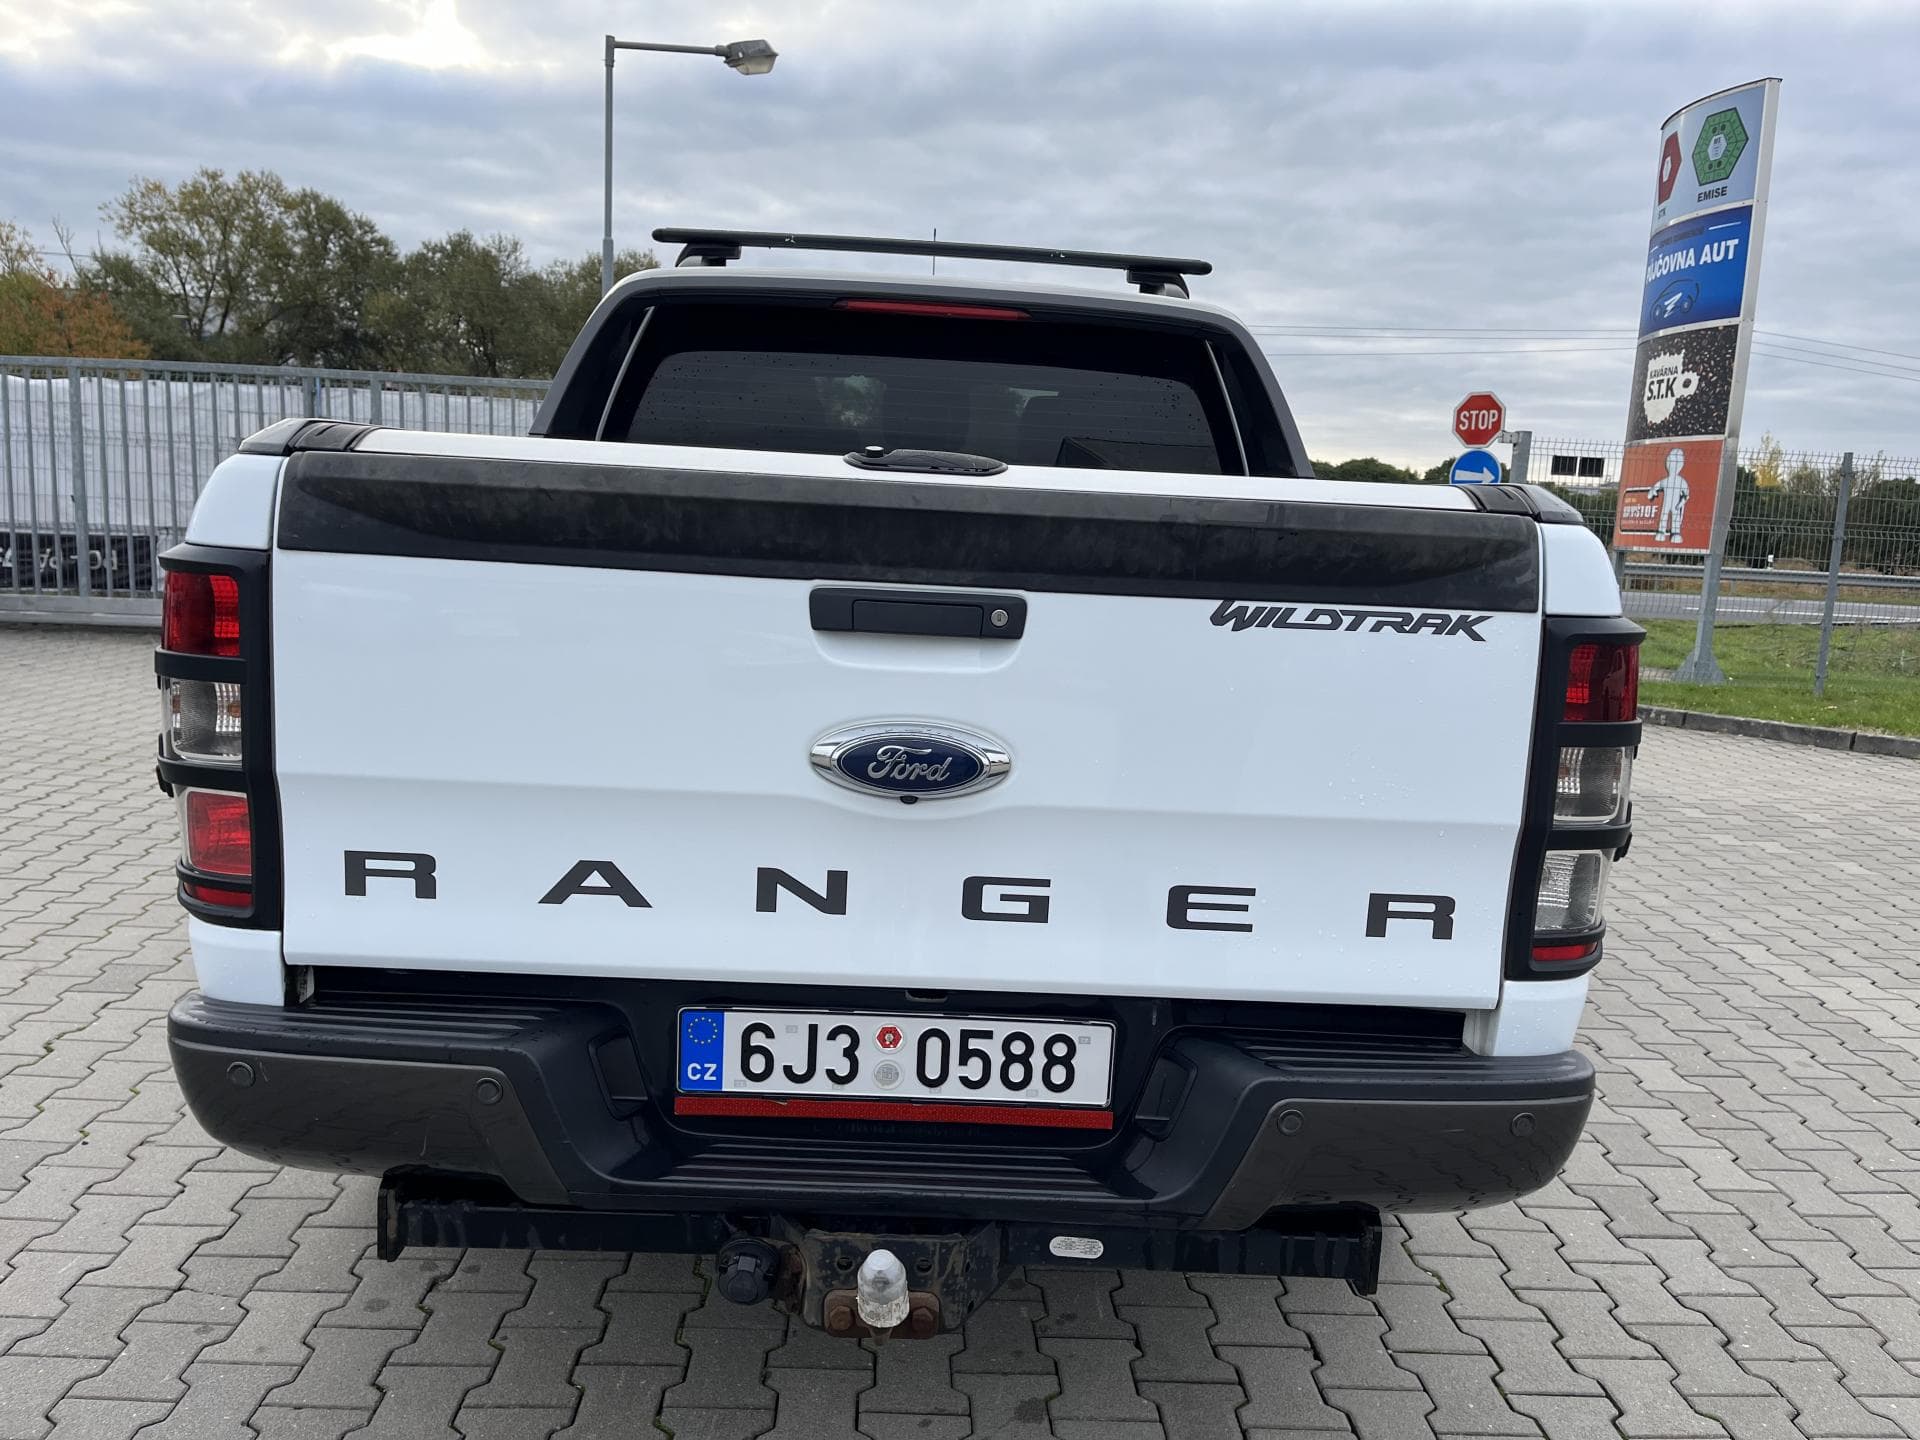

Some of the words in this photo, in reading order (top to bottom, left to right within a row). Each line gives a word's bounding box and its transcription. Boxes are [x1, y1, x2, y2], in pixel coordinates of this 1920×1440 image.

[1697, 186, 1728, 203] EMISE
[1699, 239, 1738, 265] AUT
[1649, 365, 1679, 379] KAVÁRNA
[1647, 378, 1677, 401] S.T.K
[1459, 409, 1499, 431] STOP
[1209, 599, 1495, 642] WILDTRAK
[867, 744, 953, 782] Ford
[343, 849, 1457, 941] RANGER
[739, 1021, 861, 1086] 6J3
[915, 1027, 1077, 1094] 0588
[686, 1062, 718, 1082] CZ
